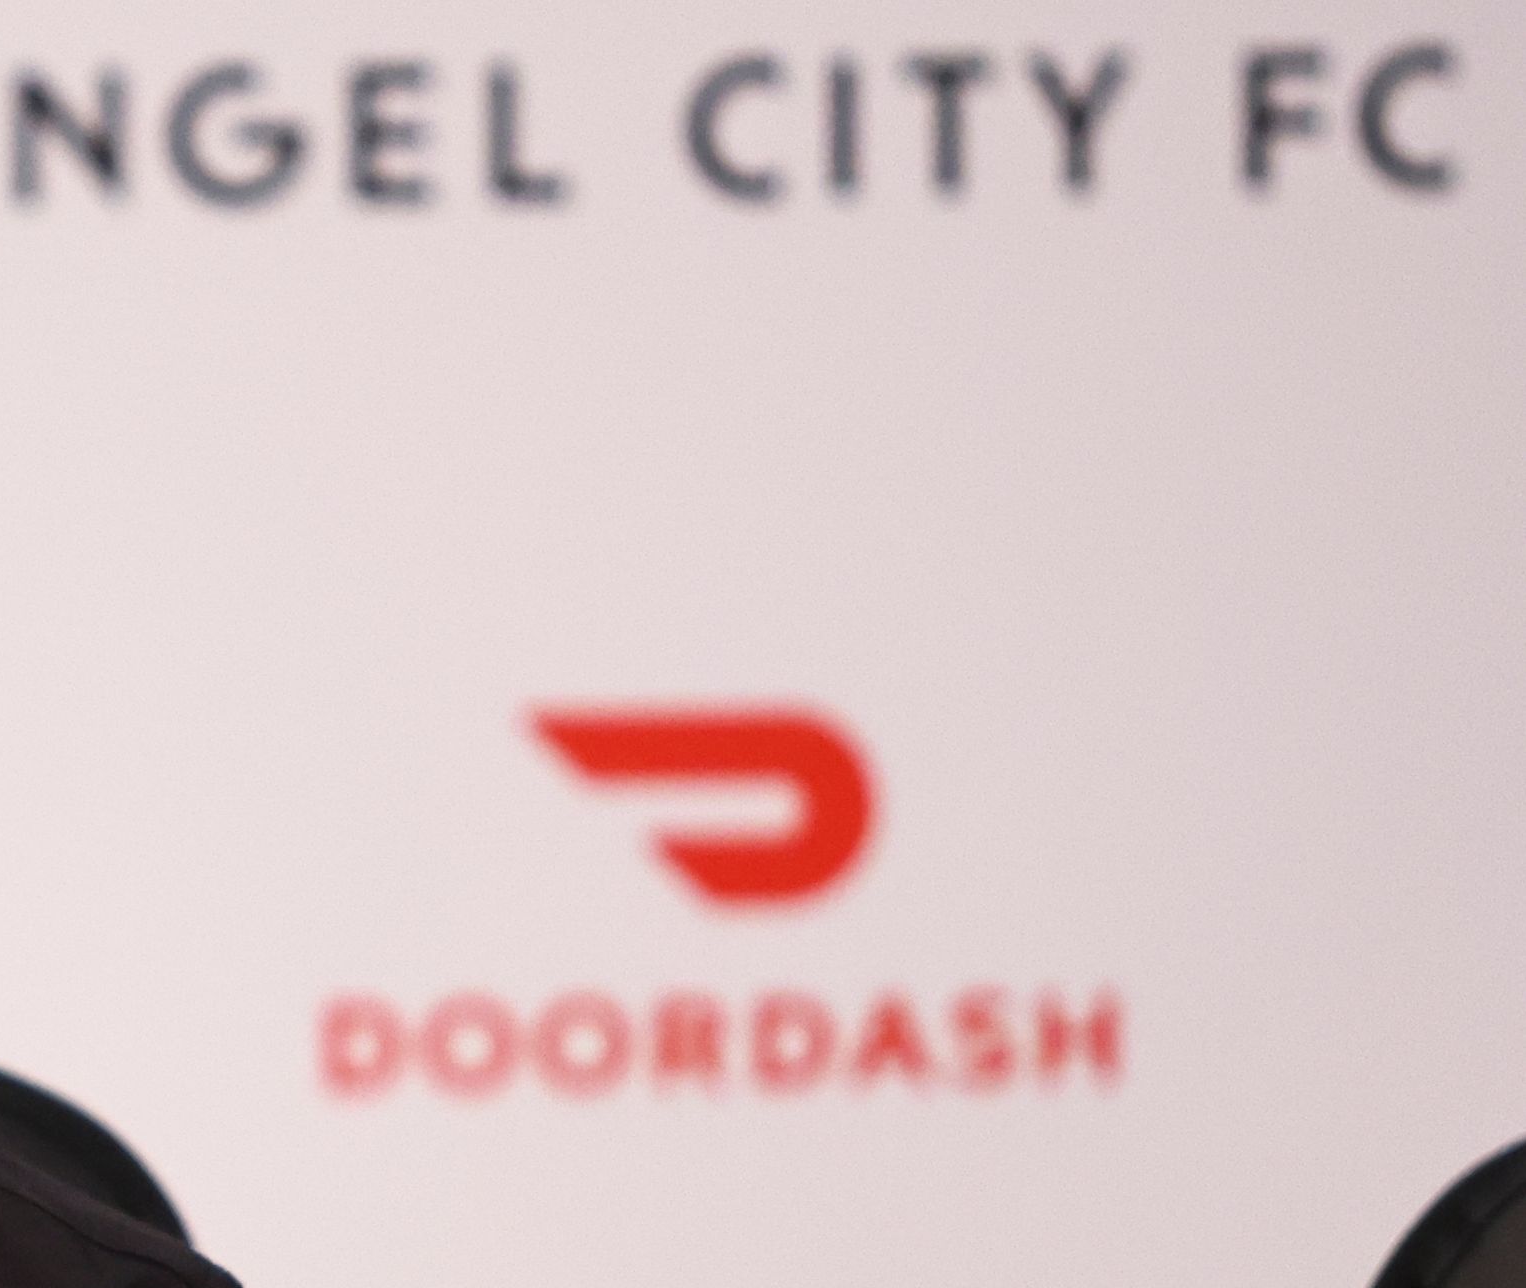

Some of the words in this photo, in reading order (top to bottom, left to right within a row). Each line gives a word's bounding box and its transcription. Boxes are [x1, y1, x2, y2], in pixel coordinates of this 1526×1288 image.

[680, 48, 1131, 208] CITY
[1235, 40, 1460, 198] FC
[318, 985, 1128, 1098] DOORDASH
